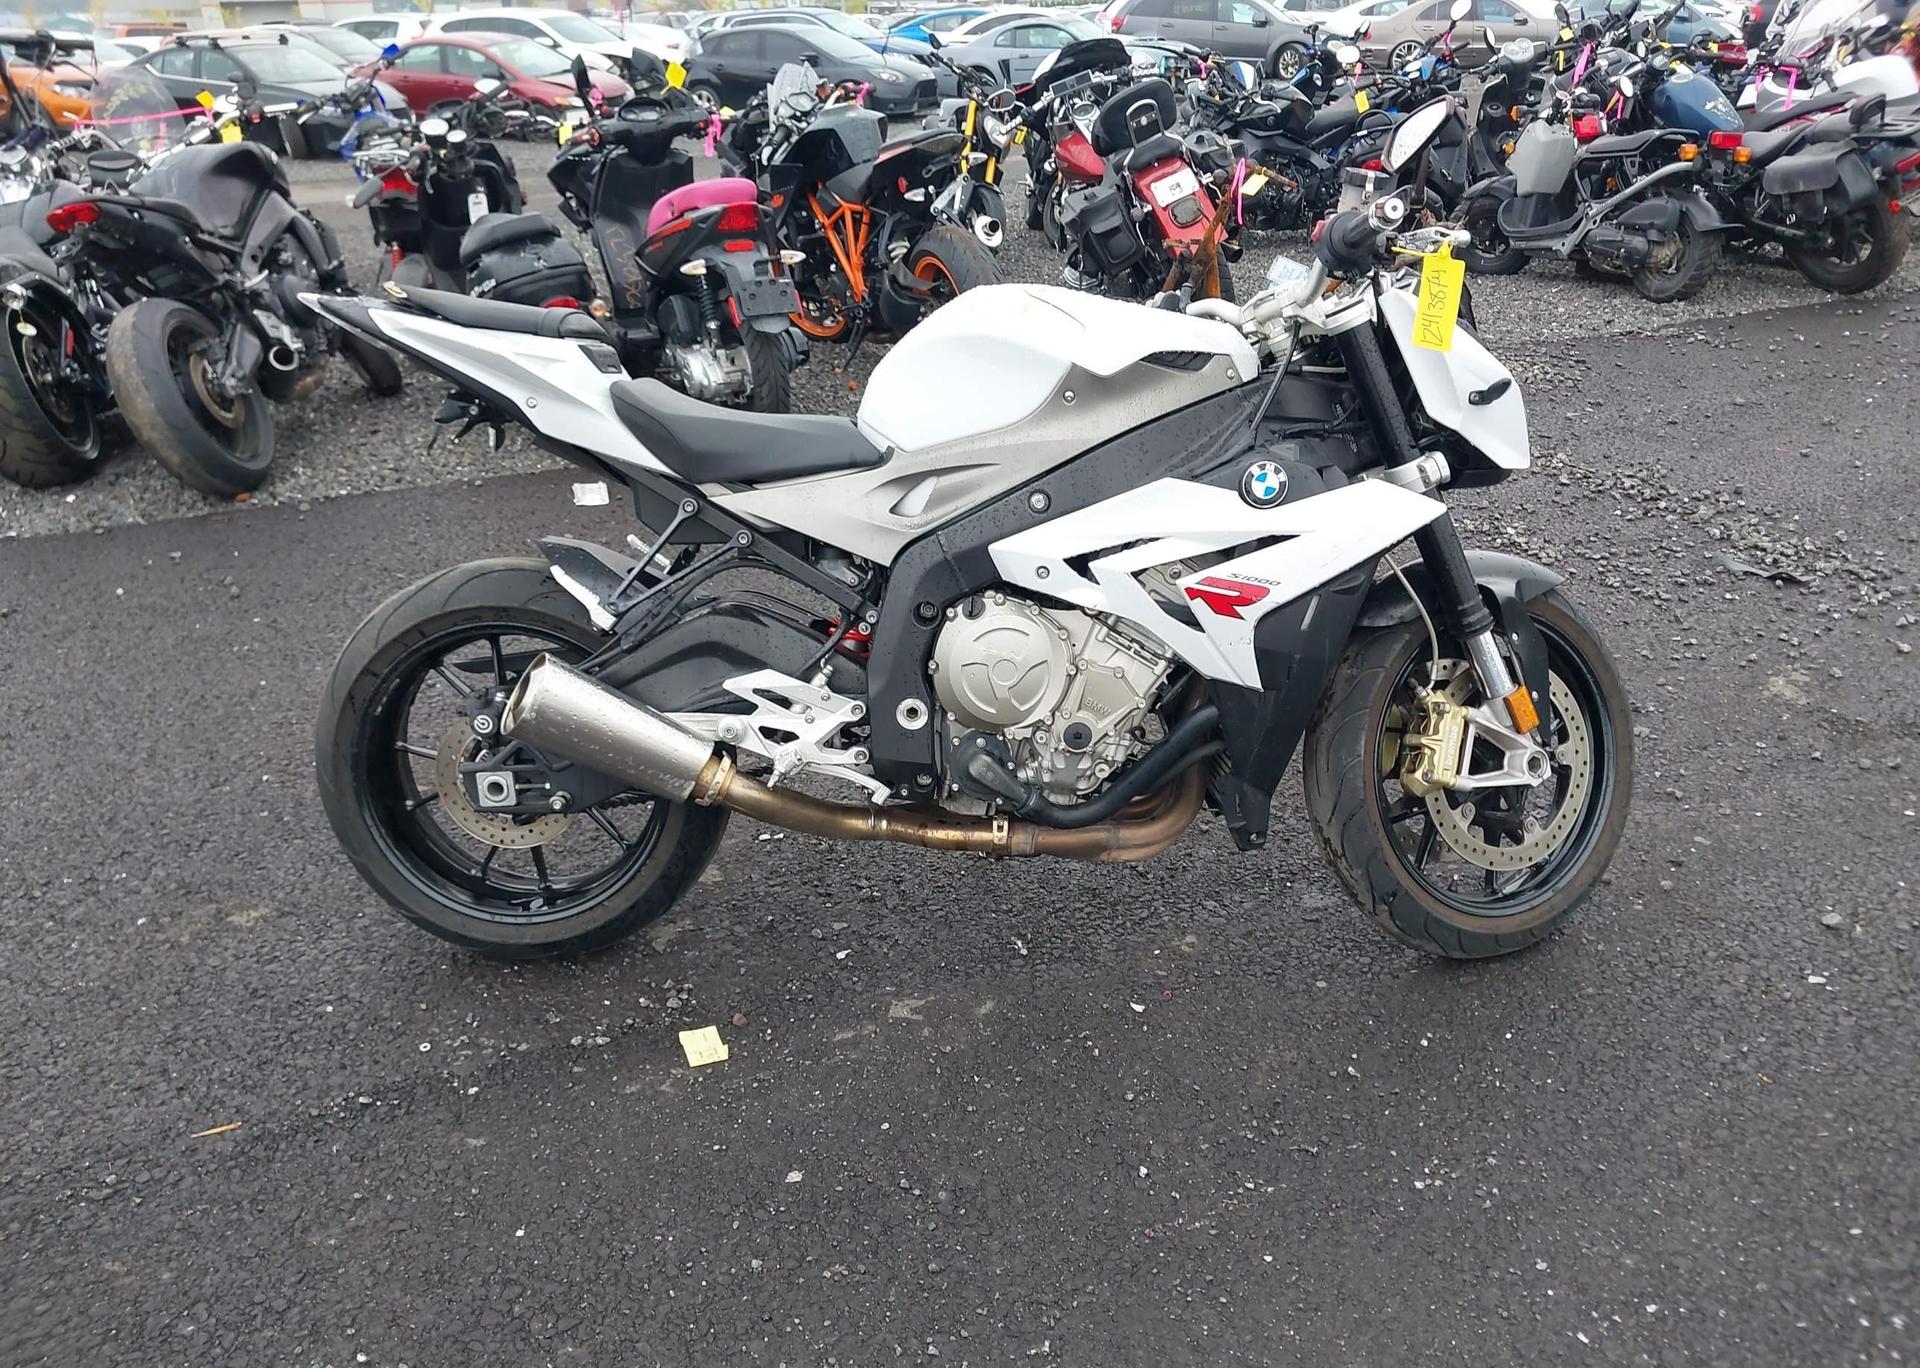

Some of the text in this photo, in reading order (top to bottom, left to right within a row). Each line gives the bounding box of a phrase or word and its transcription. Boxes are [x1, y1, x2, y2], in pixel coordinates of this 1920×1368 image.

[1226, 572, 1281, 586] S1000
[1184, 576, 1270, 620] R
[1084, 697, 1111, 716] BMW
[1447, 726, 1458, 768] brembo
